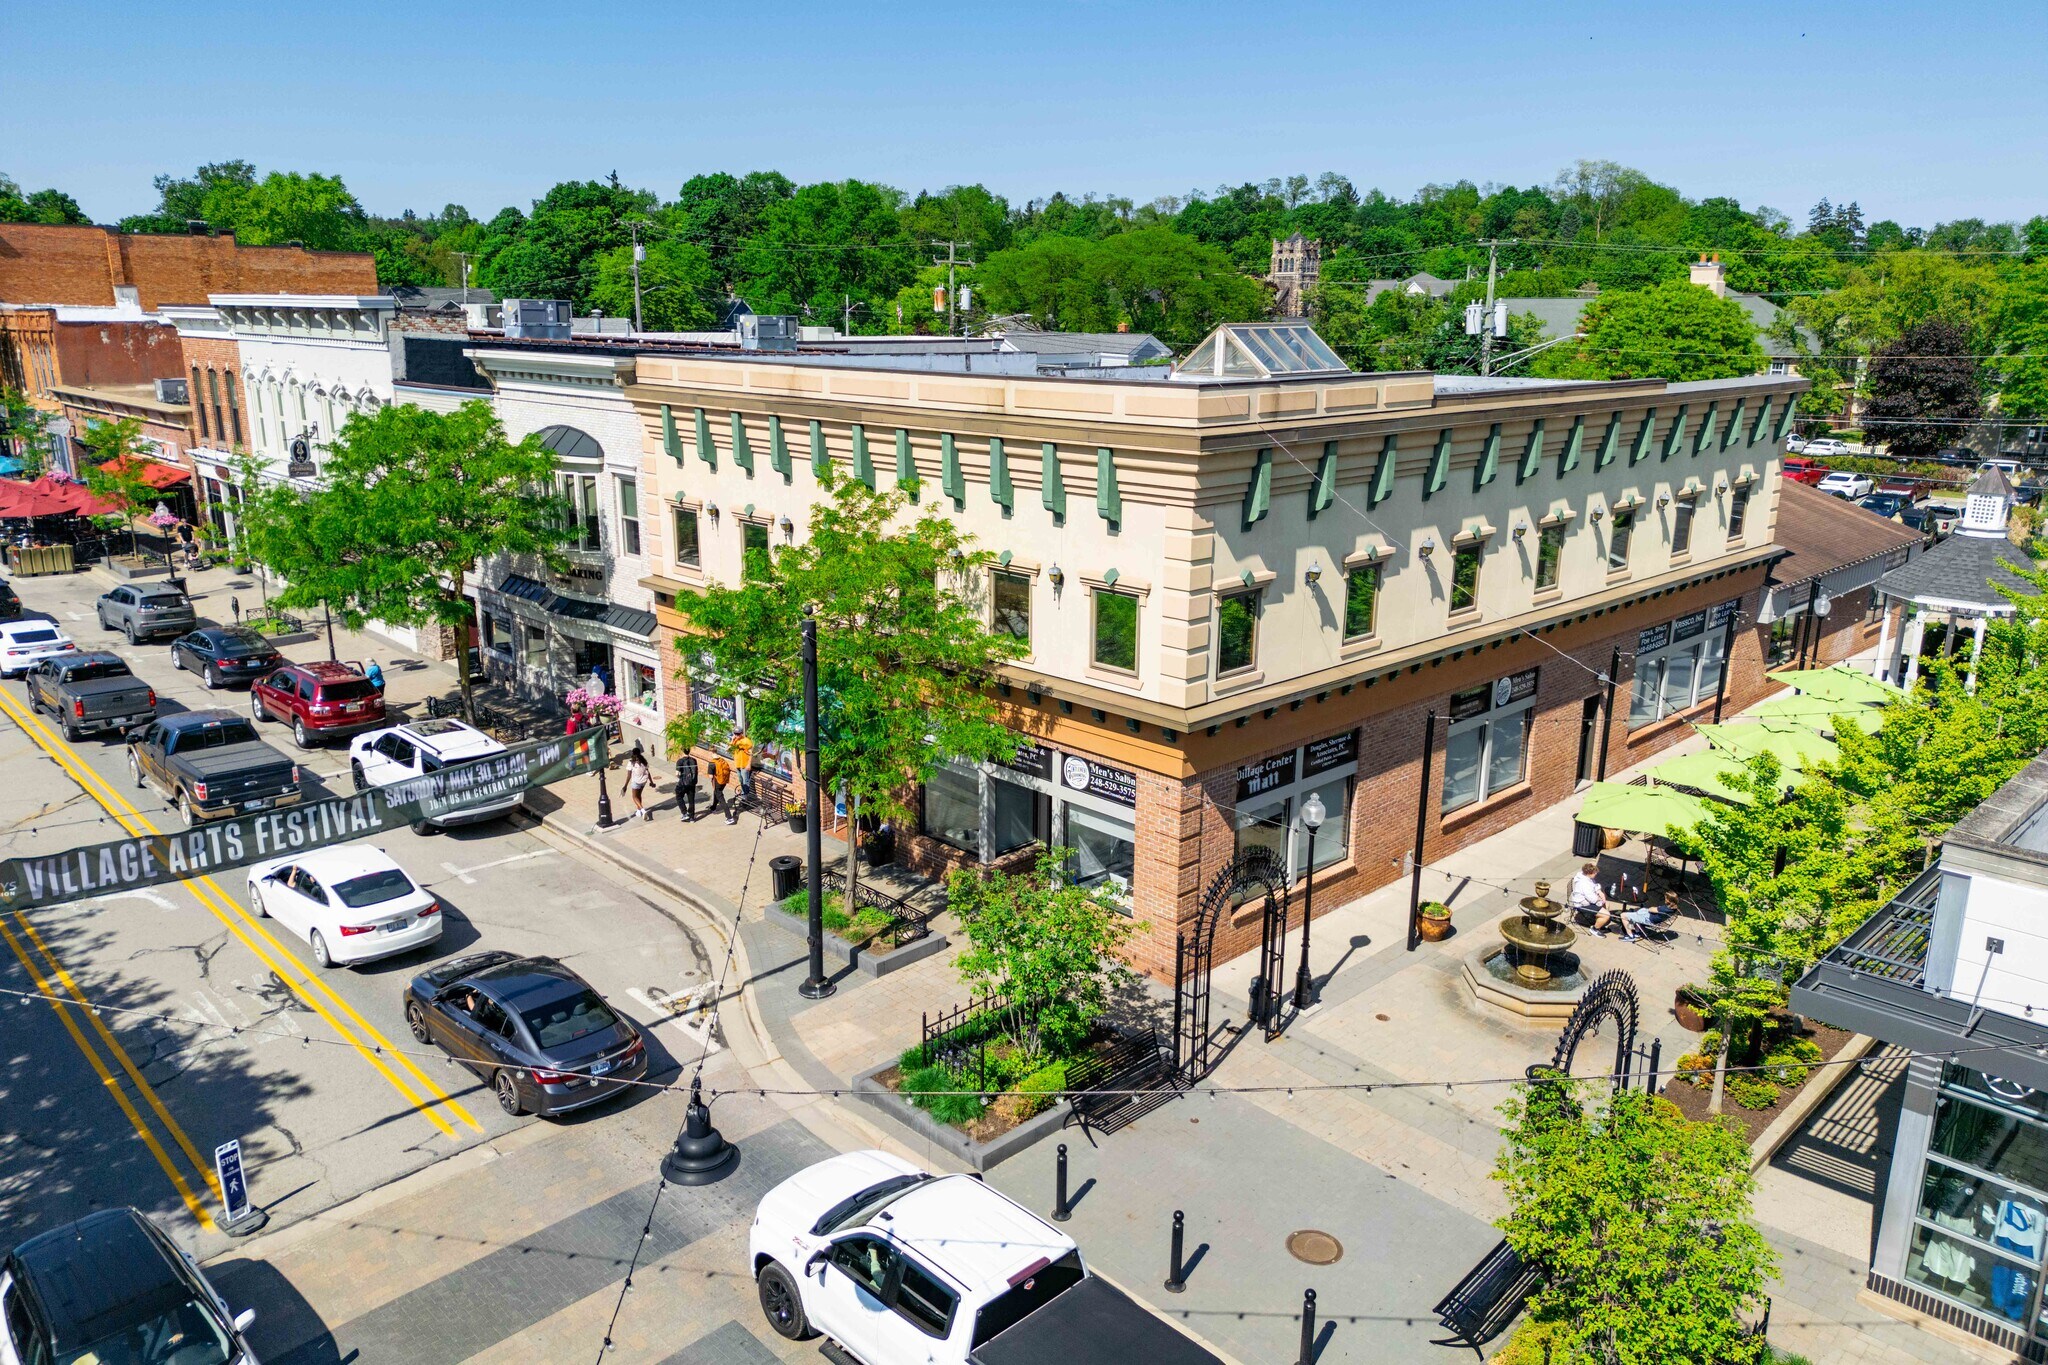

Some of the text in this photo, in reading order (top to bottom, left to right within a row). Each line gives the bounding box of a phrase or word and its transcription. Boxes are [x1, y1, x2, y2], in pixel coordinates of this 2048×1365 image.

[1655, 624, 1668, 633] SPACE
[384, 774, 448, 808] SATURDAY,
[449, 766, 474, 791] MAY
[476, 762, 495, 783] 30,
[495, 758, 508, 778] 10
[509, 752, 527, 775] AM
[537, 743, 560, 766] 7PM
[1090, 764, 1113, 779] Men's
[1114, 771, 1136, 786] Salon
[1236, 754, 1294, 781] Village Center
[429, 774, 528, 811] JOIN US IN CENTRAL PARK
[1090, 776, 1136, 798] 248-529-3575
[1247, 770, 1279, 794] Mall
[23, 793, 382, 900] VILLAGE ARTS FESTIVAL
[220, 1152, 239, 1167] STOP
